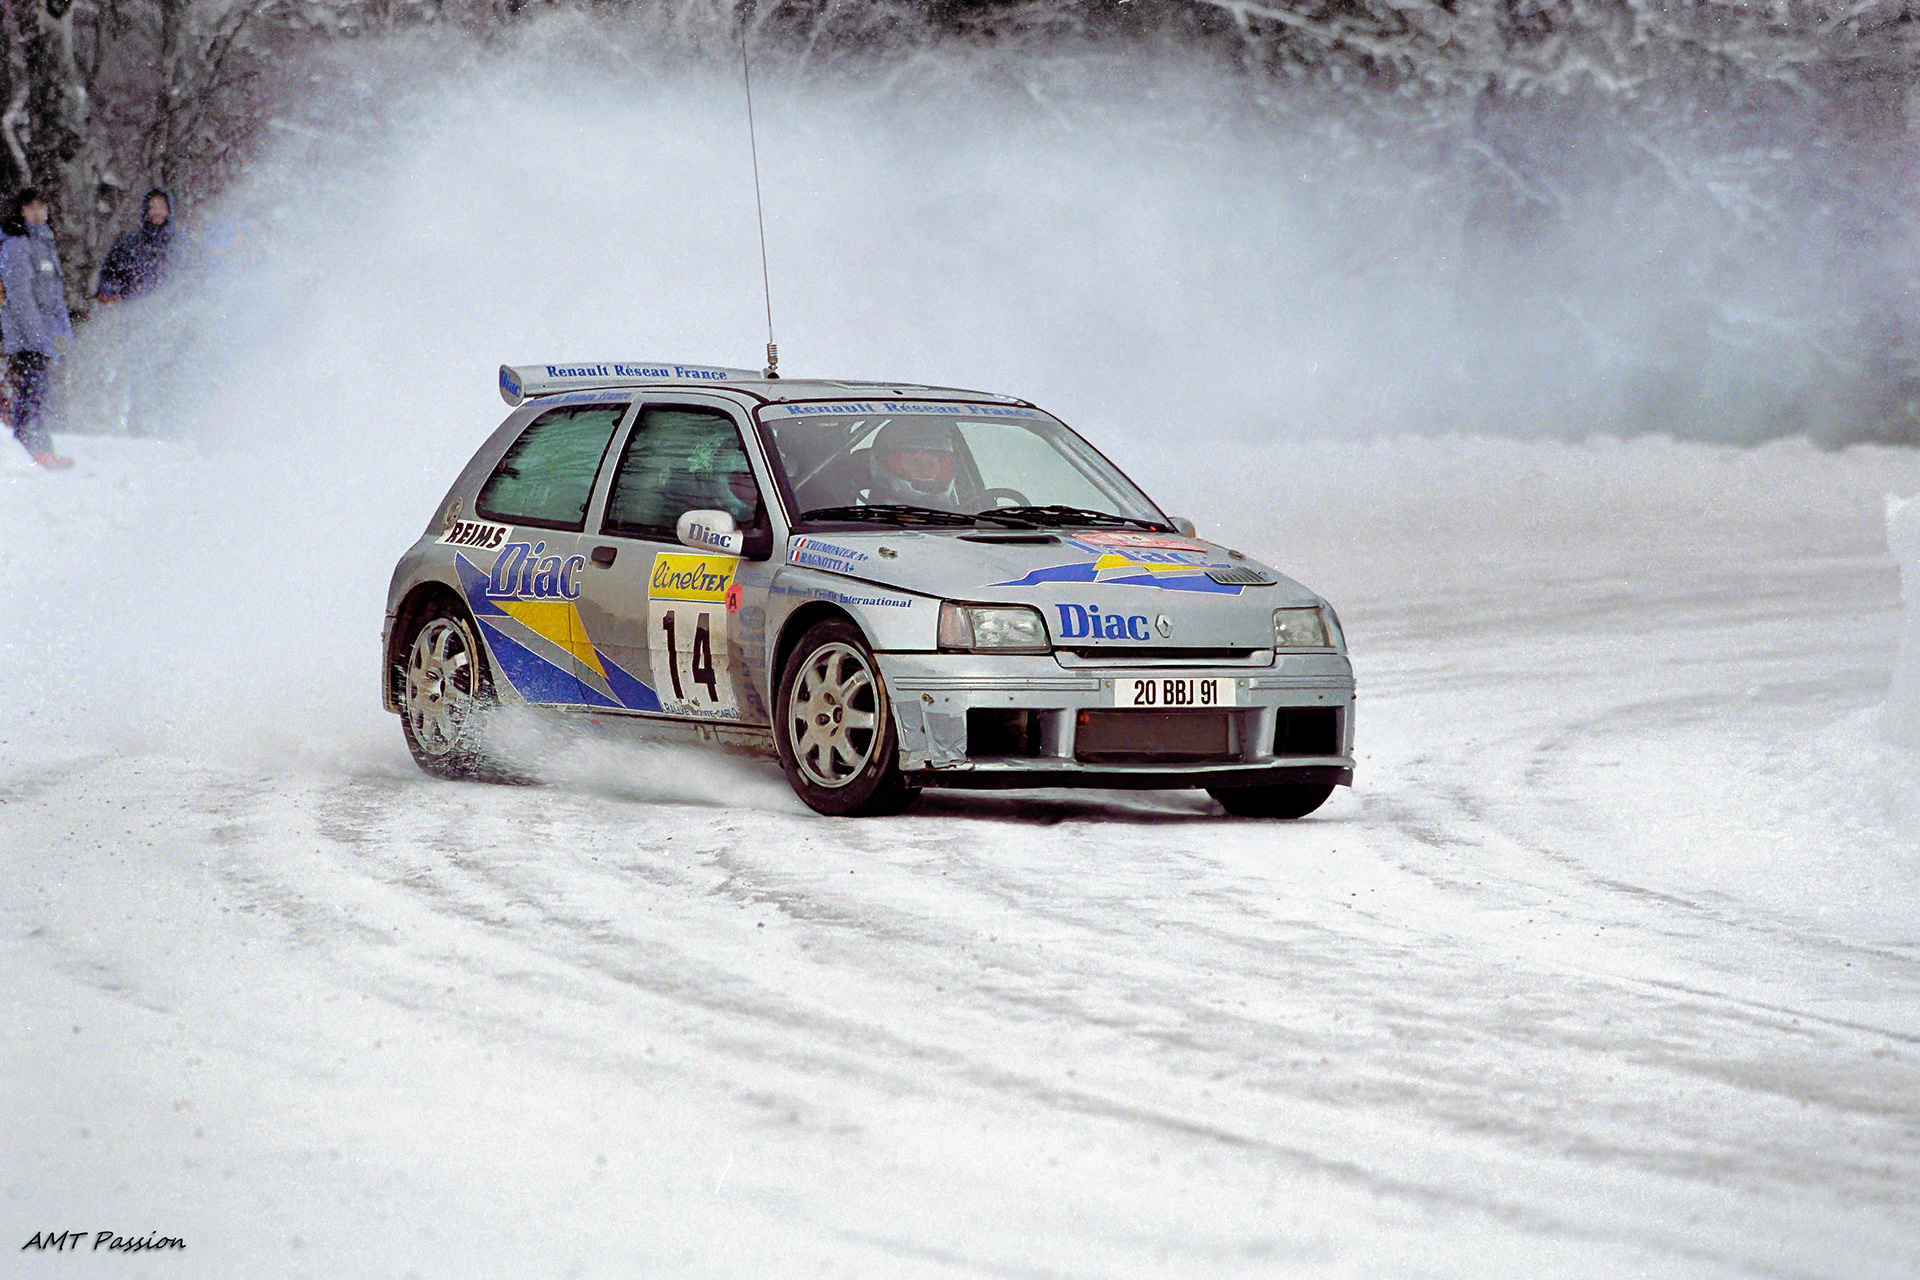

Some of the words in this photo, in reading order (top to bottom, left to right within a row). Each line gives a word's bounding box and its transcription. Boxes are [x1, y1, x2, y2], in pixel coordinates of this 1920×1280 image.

[547, 365, 609, 377] Renault
[615, 365, 669, 377] Réseau
[675, 366, 727, 380] France
[786, 402, 874, 415] Renault
[883, 402, 960, 415] Réseau
[444, 521, 506, 549] REIMS
[689, 523, 732, 548] Diac
[486, 541, 585, 600] Diac
[729, 593, 737, 609] A
[839, 593, 913, 608] International
[1055, 604, 1150, 641] Diac
[663, 610, 719, 703] 14
[1134, 679, 1156, 705] 20
[1162, 679, 1195, 705] BBJ
[1200, 679, 1218, 705] 91
